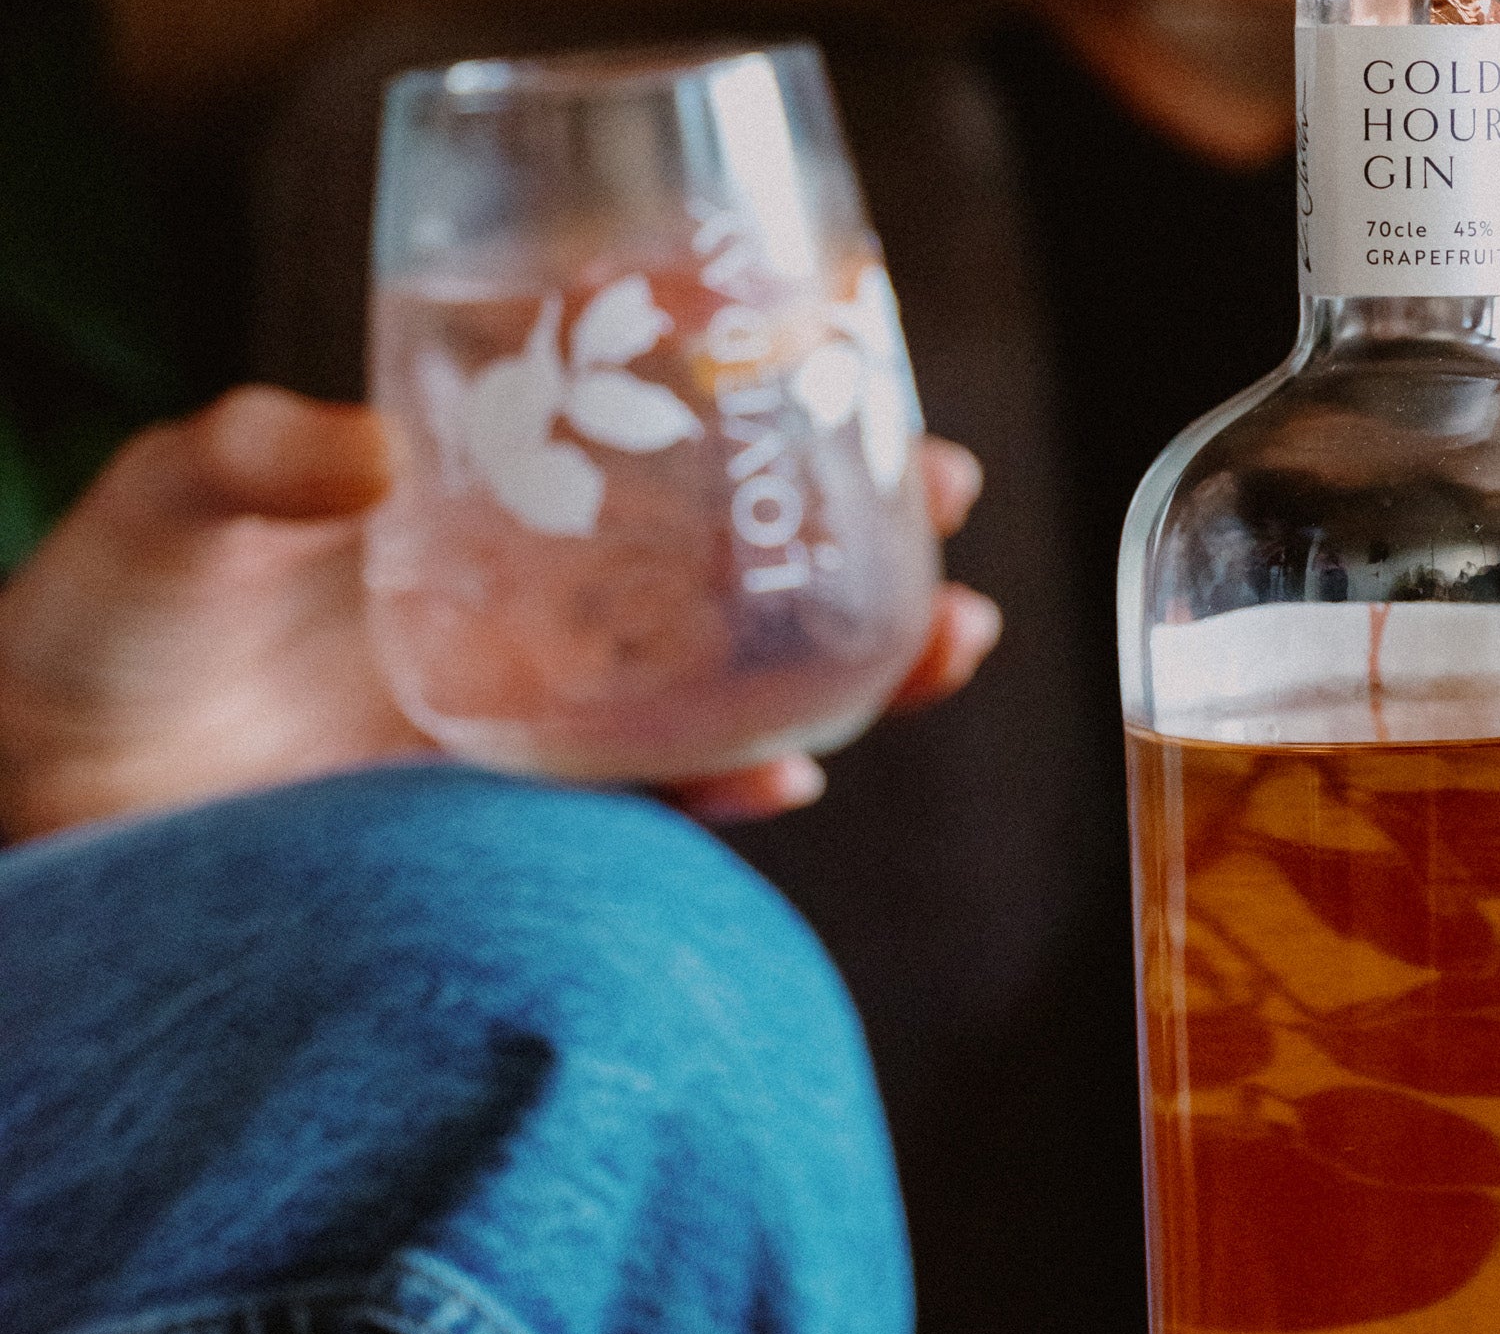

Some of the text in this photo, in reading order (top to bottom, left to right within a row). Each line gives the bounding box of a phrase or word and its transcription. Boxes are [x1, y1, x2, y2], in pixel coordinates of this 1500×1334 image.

[1362, 154, 1455, 190] GIN
[1365, 220, 1428, 239] 70cle
[1453, 220, 1494, 239] 45%
